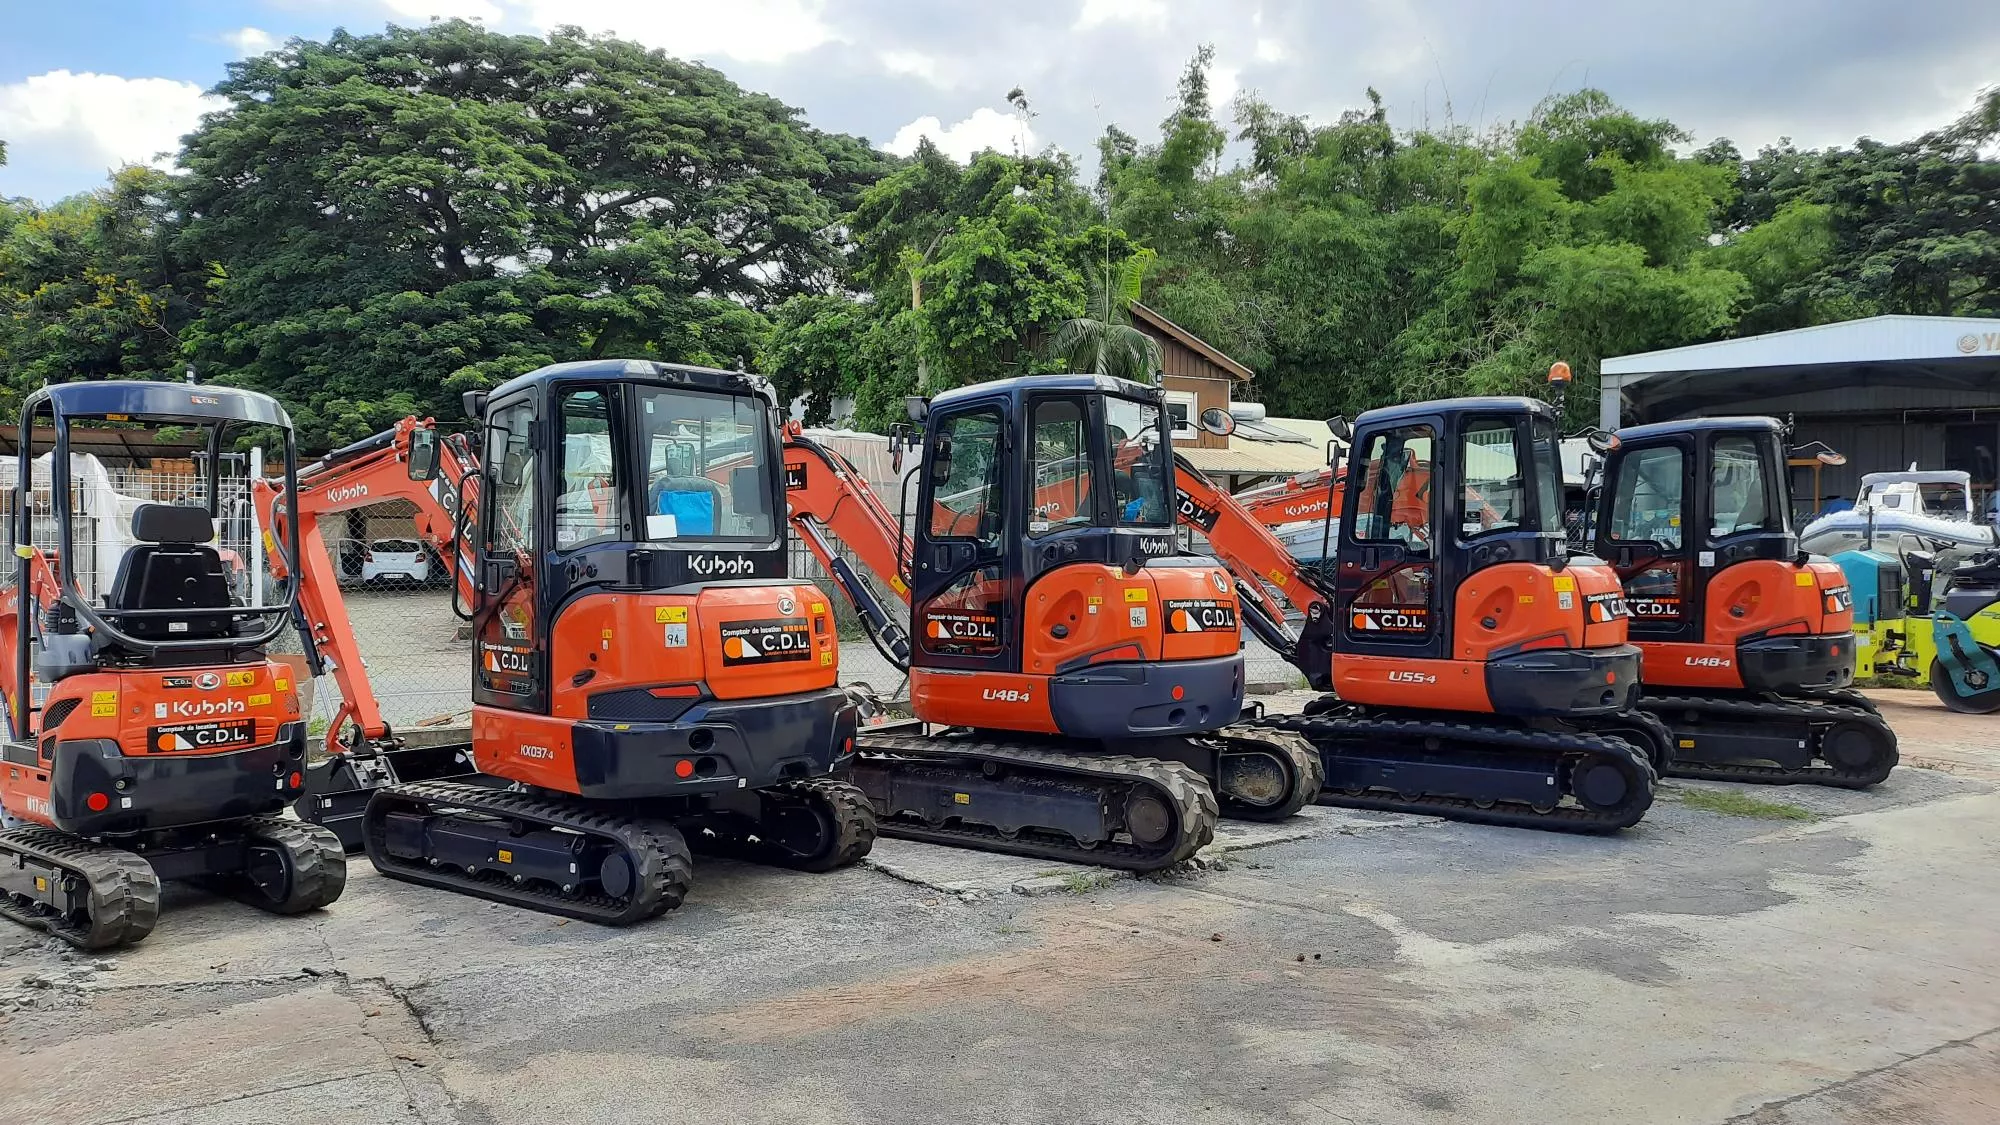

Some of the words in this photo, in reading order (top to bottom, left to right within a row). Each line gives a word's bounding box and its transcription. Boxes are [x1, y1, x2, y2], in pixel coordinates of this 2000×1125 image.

[327, 482, 368, 502] Kubota
[1140, 537, 1168, 554] Kubota
[687, 554, 754, 575] Kubota
[1169, 600, 1193, 609] Comptoir
[1201, 599, 1216, 607] location
[1636, 603, 1680, 615] C.D.L.
[1202, 608, 1235, 627] C.D.L.
[1381, 614, 1426, 628] C.D.L.
[722, 628, 751, 638] Comptoir
[751, 627, 759, 635] de
[760, 625, 782, 634] location
[952, 621, 995, 637] C.D.L.
[761, 632, 810, 651] C.D.L.
[173, 697, 245, 717] Kubota
[157, 725, 186, 734] Comptoir
[195, 722, 218, 730] location
[195, 727, 249, 745] C.D.L.
